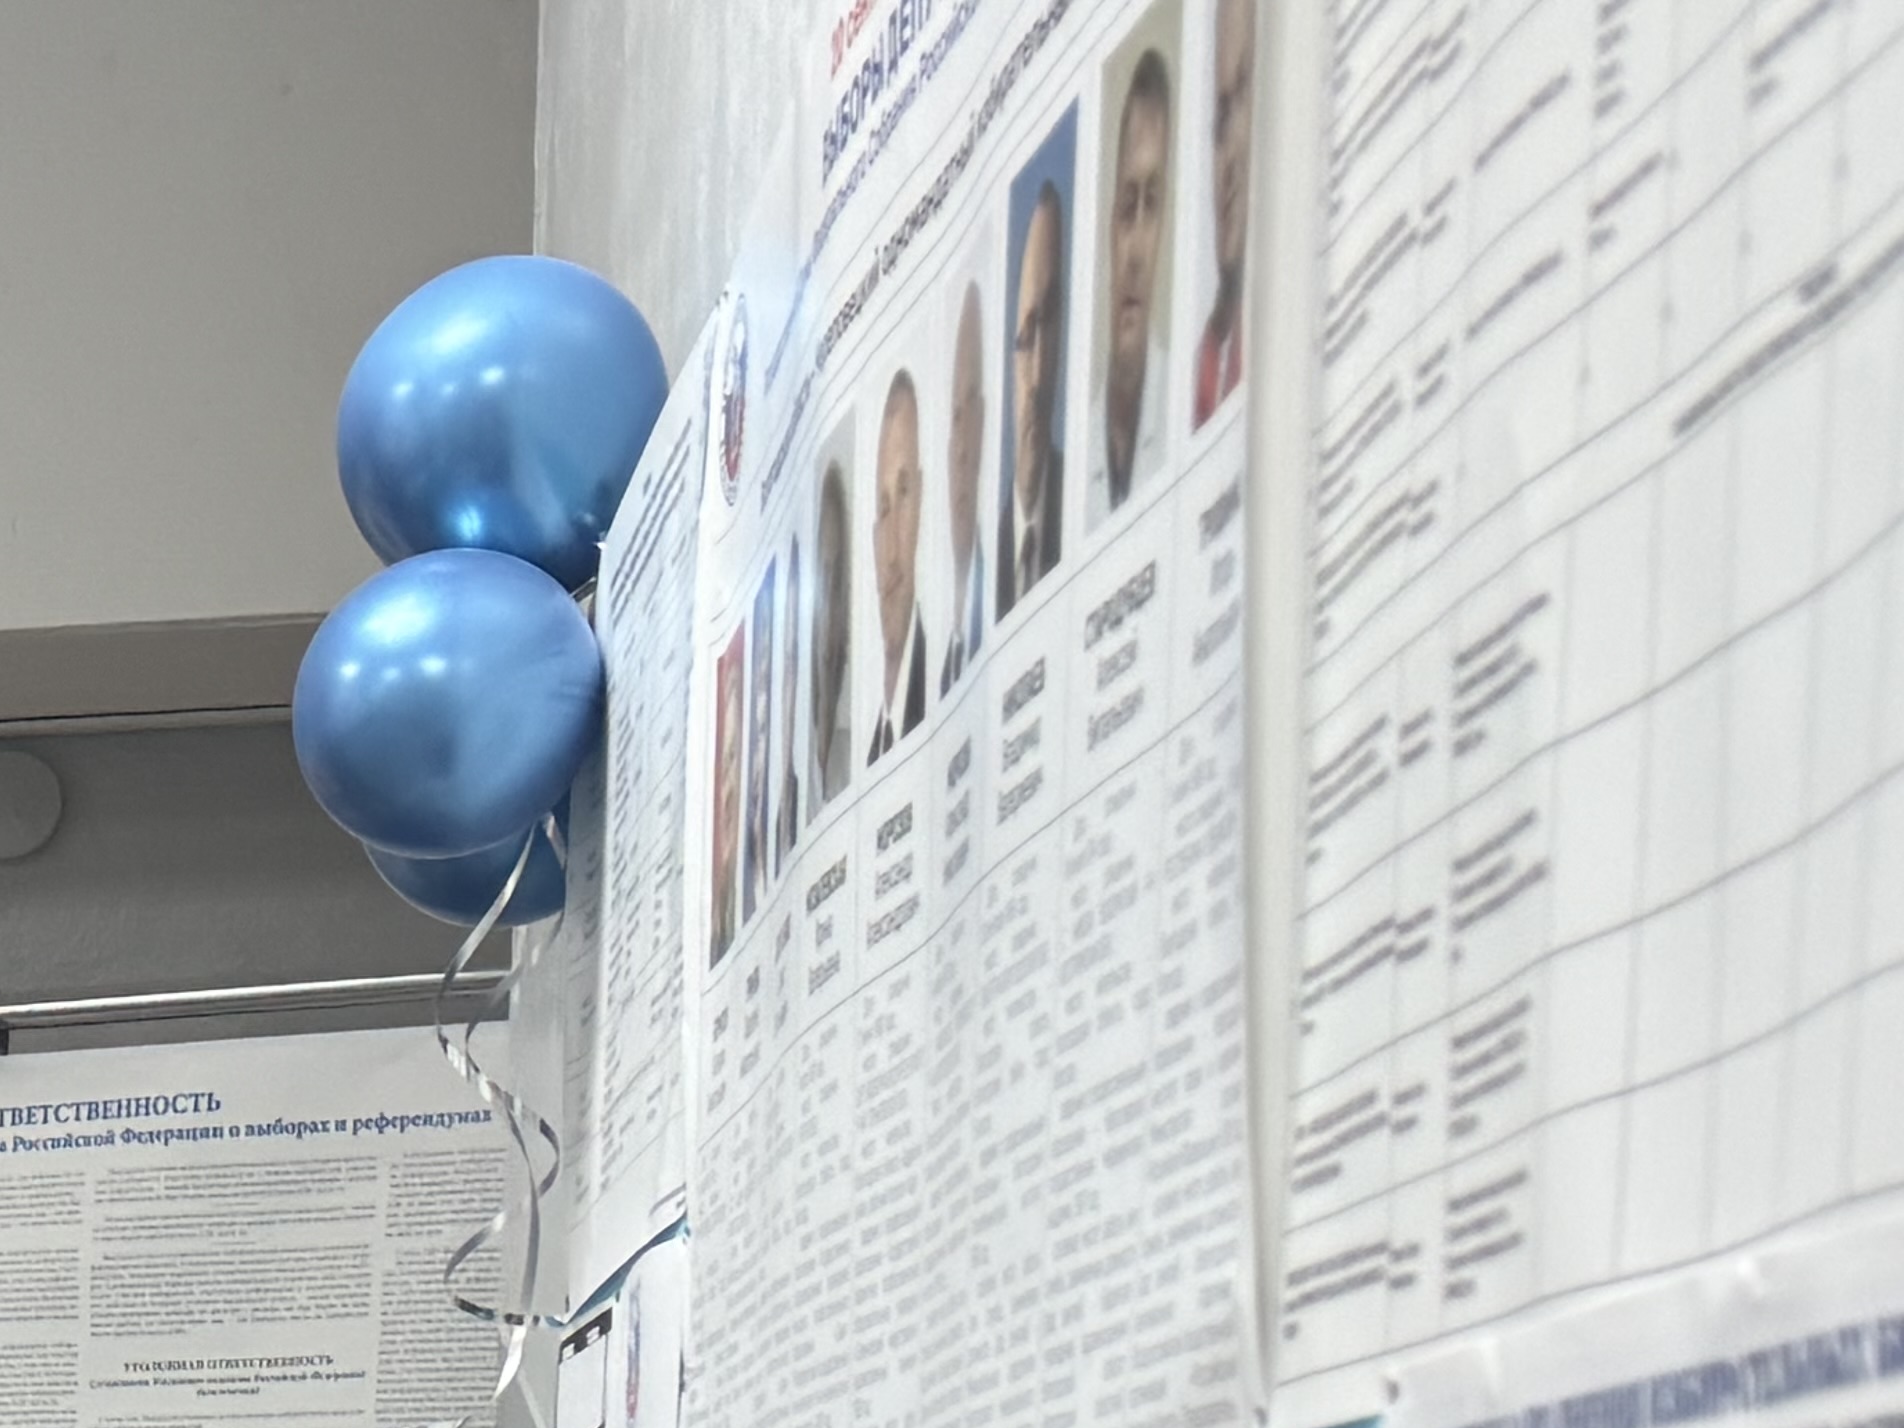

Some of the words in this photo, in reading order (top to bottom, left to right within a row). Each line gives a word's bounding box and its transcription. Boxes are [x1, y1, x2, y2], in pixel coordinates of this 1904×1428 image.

[12, 1129, 115, 1152] Российской
[121, 1126, 224, 1147] Федерации
[229, 1126, 241, 1139] о
[245, 1118, 330, 1140] выборах
[334, 1119, 346, 1133] и
[352, 1109, 493, 1137] референдумах
